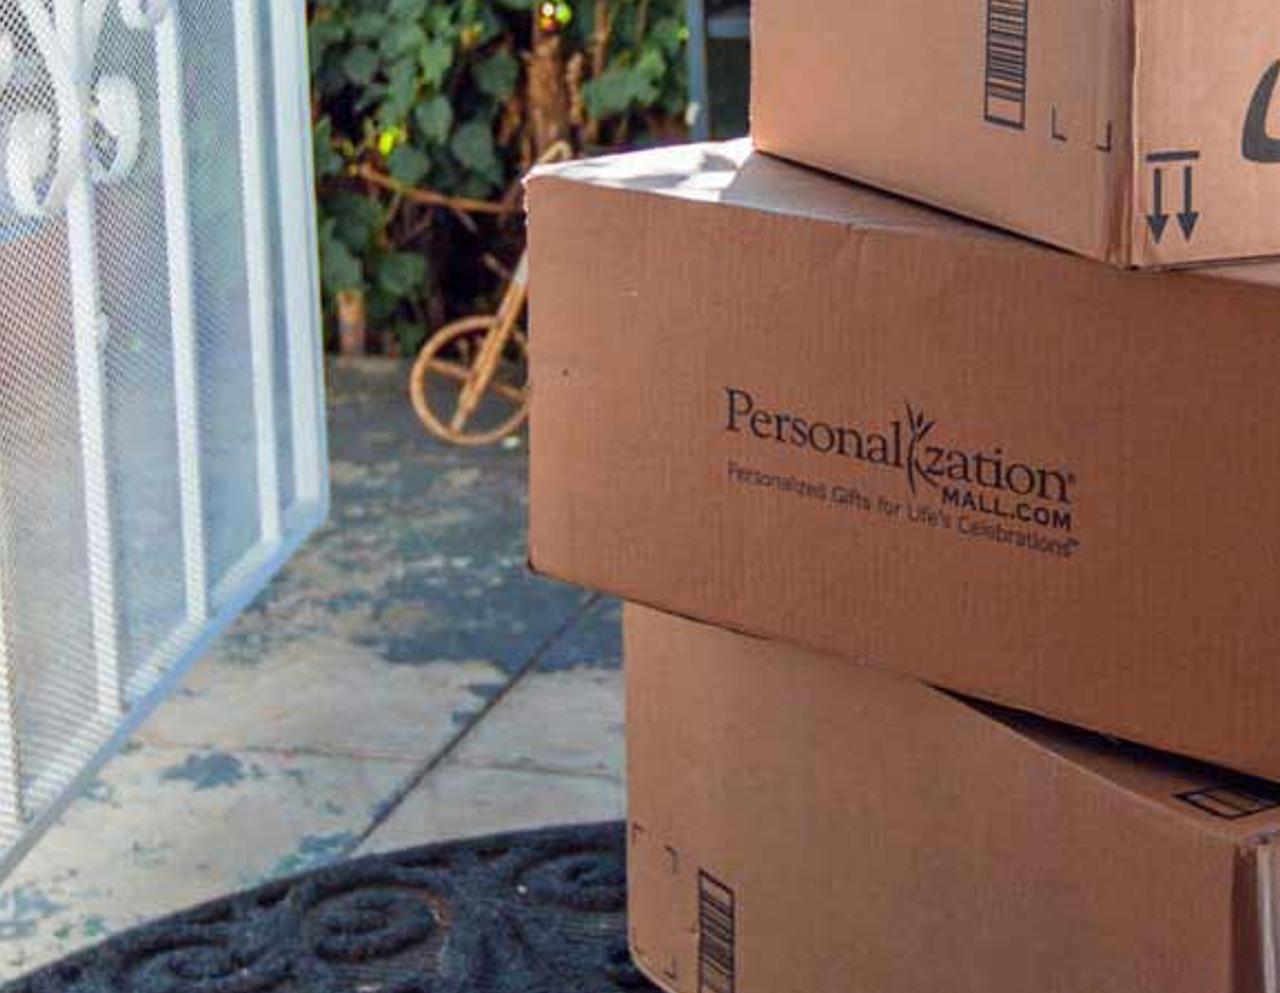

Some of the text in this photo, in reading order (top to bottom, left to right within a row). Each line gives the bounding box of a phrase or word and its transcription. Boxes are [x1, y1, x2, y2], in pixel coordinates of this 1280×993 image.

[727, 461, 828, 500] Personalized
[830, 486, 872, 512] Gifts
[877, 497, 903, 517] for
[942, 486, 1071, 532] MALL.COM
